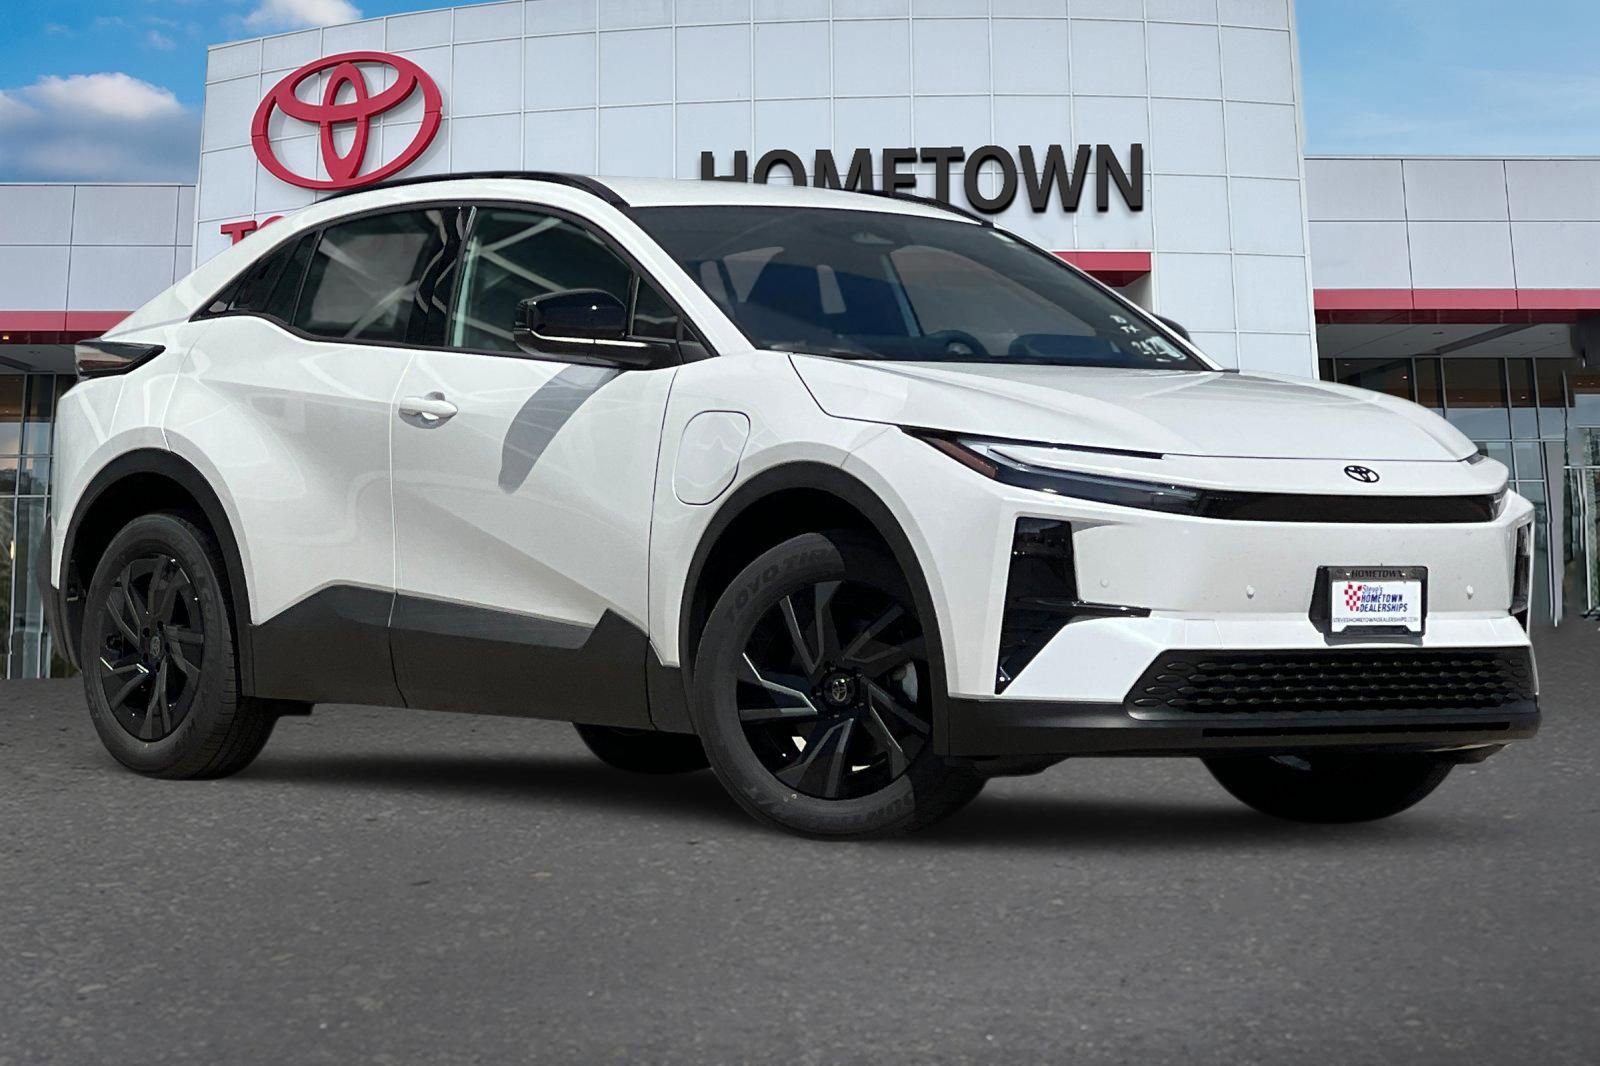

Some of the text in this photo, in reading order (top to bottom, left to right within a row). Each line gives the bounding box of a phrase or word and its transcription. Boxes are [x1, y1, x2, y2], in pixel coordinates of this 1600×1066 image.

[1351, 569, 1404, 578] HOMETOWN
[1362, 584, 1383, 594] Steve's
[1361, 594, 1403, 603] HOMETOWN
[1360, 603, 1408, 613] DEALERSHIPS
